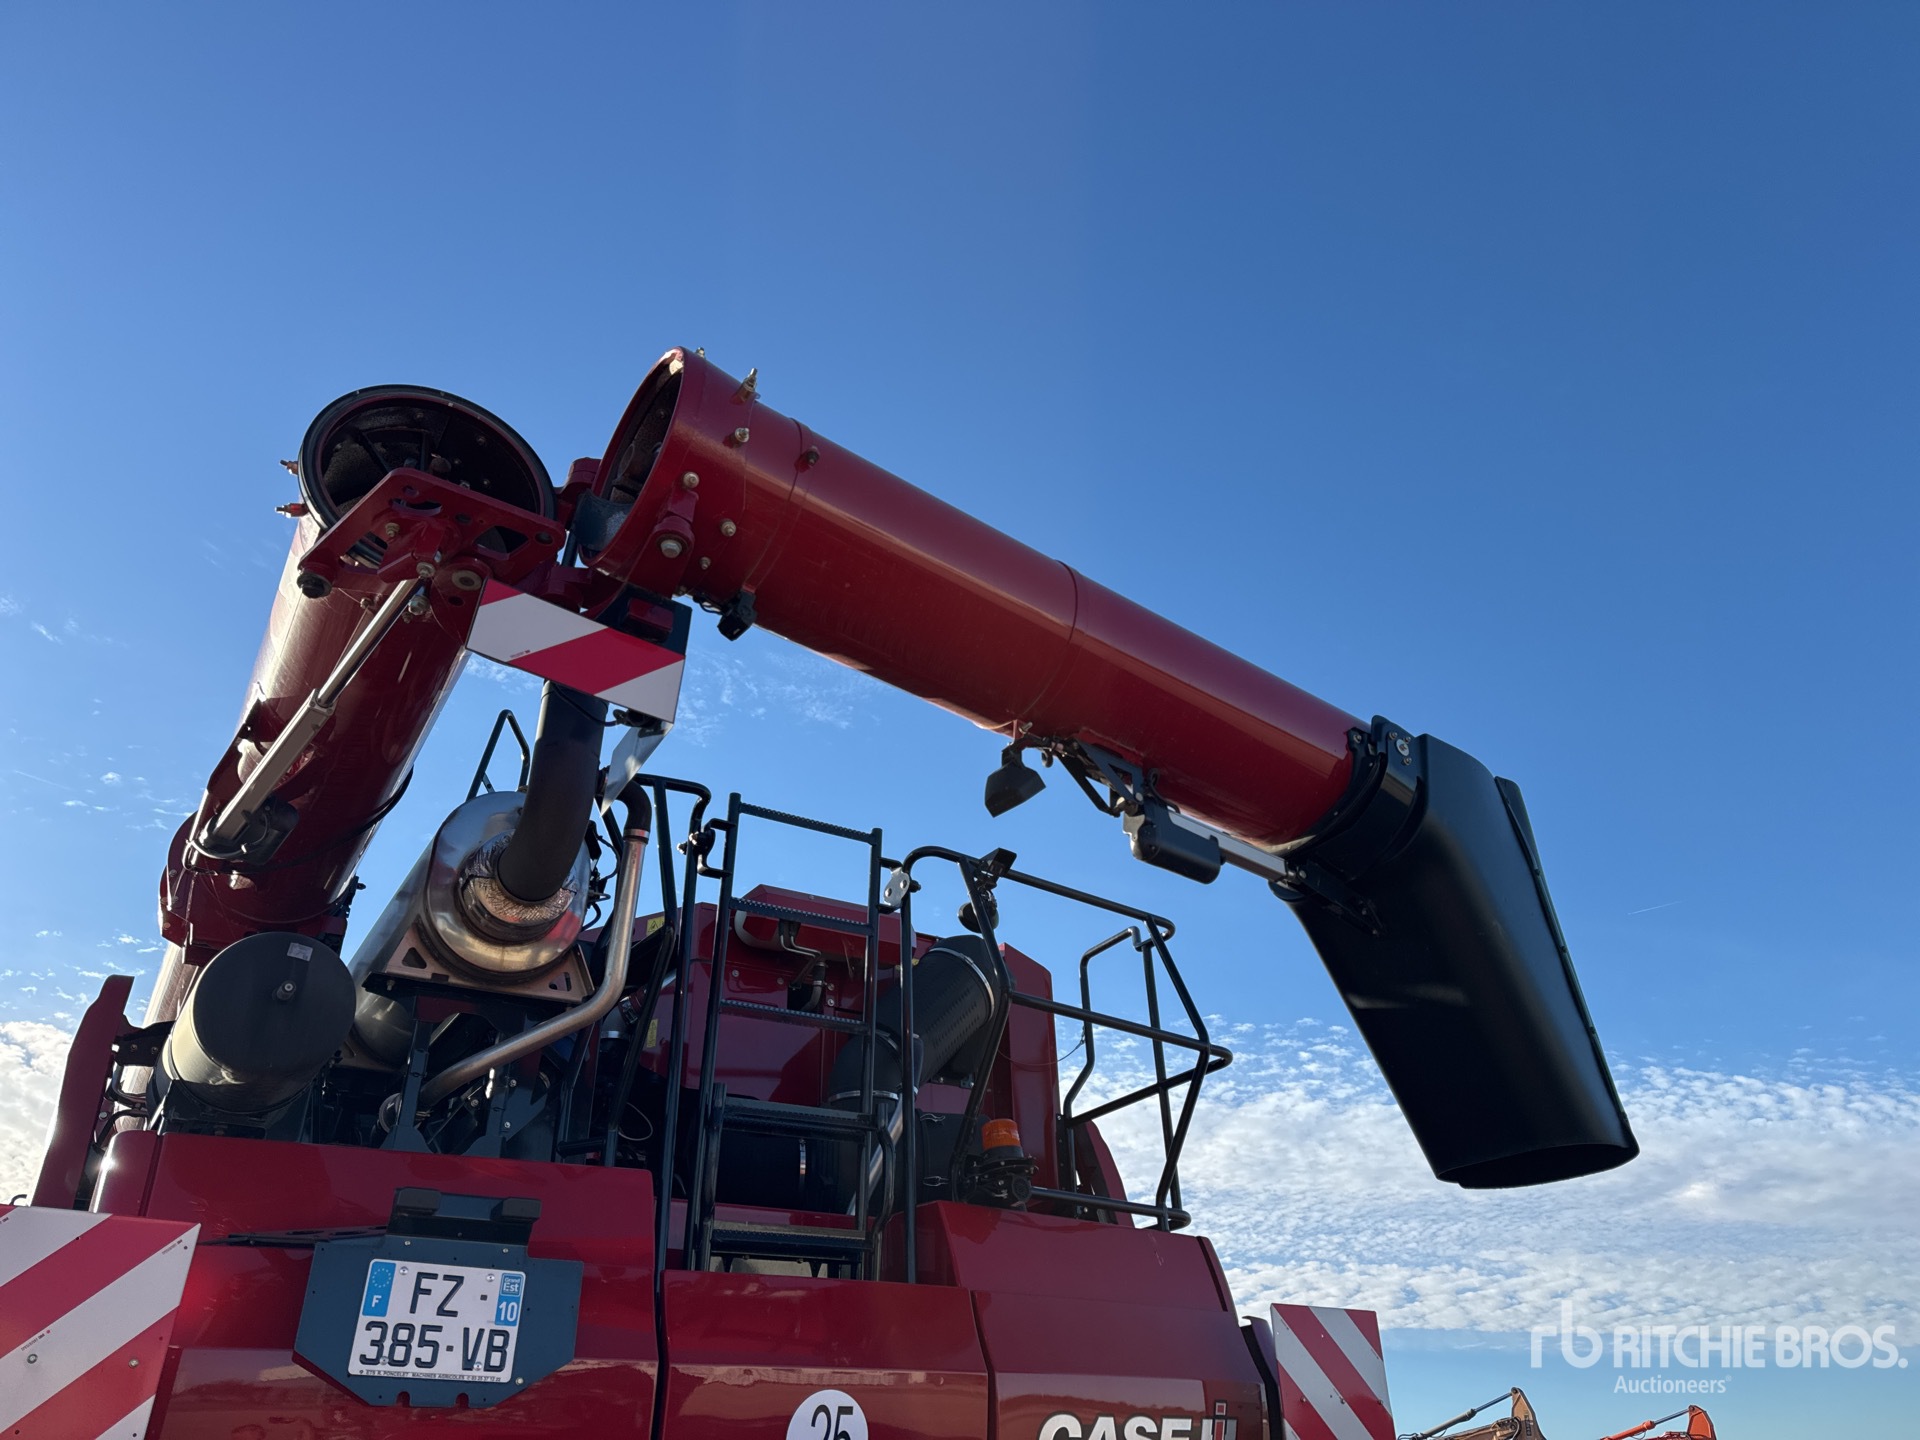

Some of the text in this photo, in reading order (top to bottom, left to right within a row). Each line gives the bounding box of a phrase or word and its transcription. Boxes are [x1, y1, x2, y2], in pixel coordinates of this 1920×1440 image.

[503, 1282, 519, 1292] Est
[371, 1295, 382, 1308] F
[499, 1301, 518, 1322] 10
[811, 1404, 854, 1440] 25
[1038, 1413, 1192, 1440] CASE
